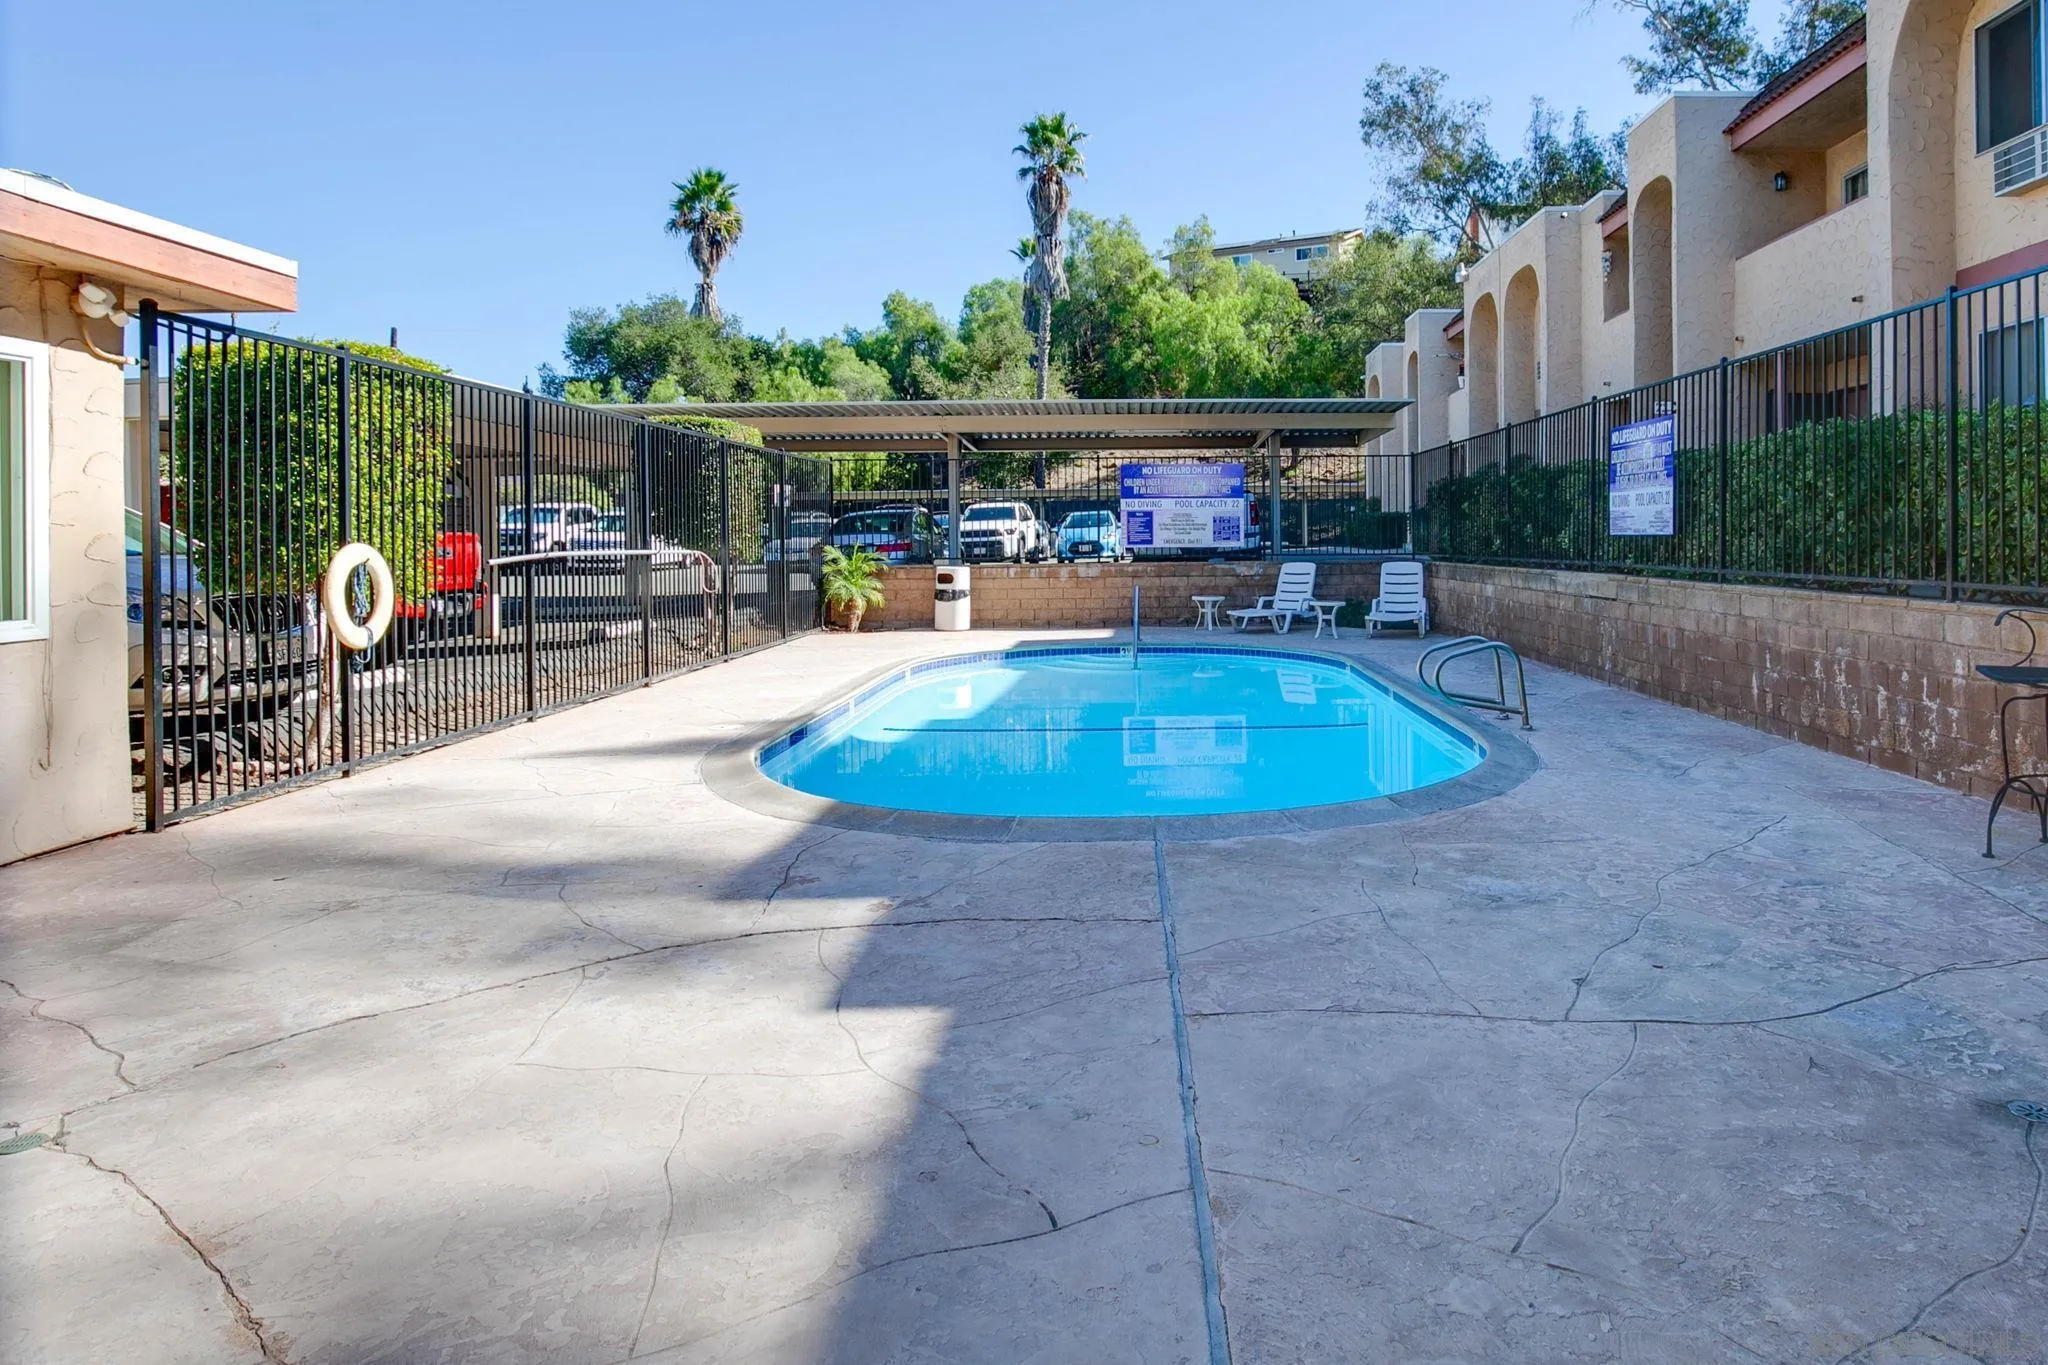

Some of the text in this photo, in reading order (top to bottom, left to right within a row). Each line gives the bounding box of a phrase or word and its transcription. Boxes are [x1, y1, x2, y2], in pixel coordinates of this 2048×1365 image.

[1611, 420, 1672, 446] NO LIFEGUARD ON DUTY
[1142, 466, 1222, 475] NO LIFEGUARD ON DUTY
[1125, 500, 1136, 508] NO
[1137, 500, 1162, 508] DIVING
[1174, 500, 1194, 508] POOL
[1231, 500, 1240, 508] 22
